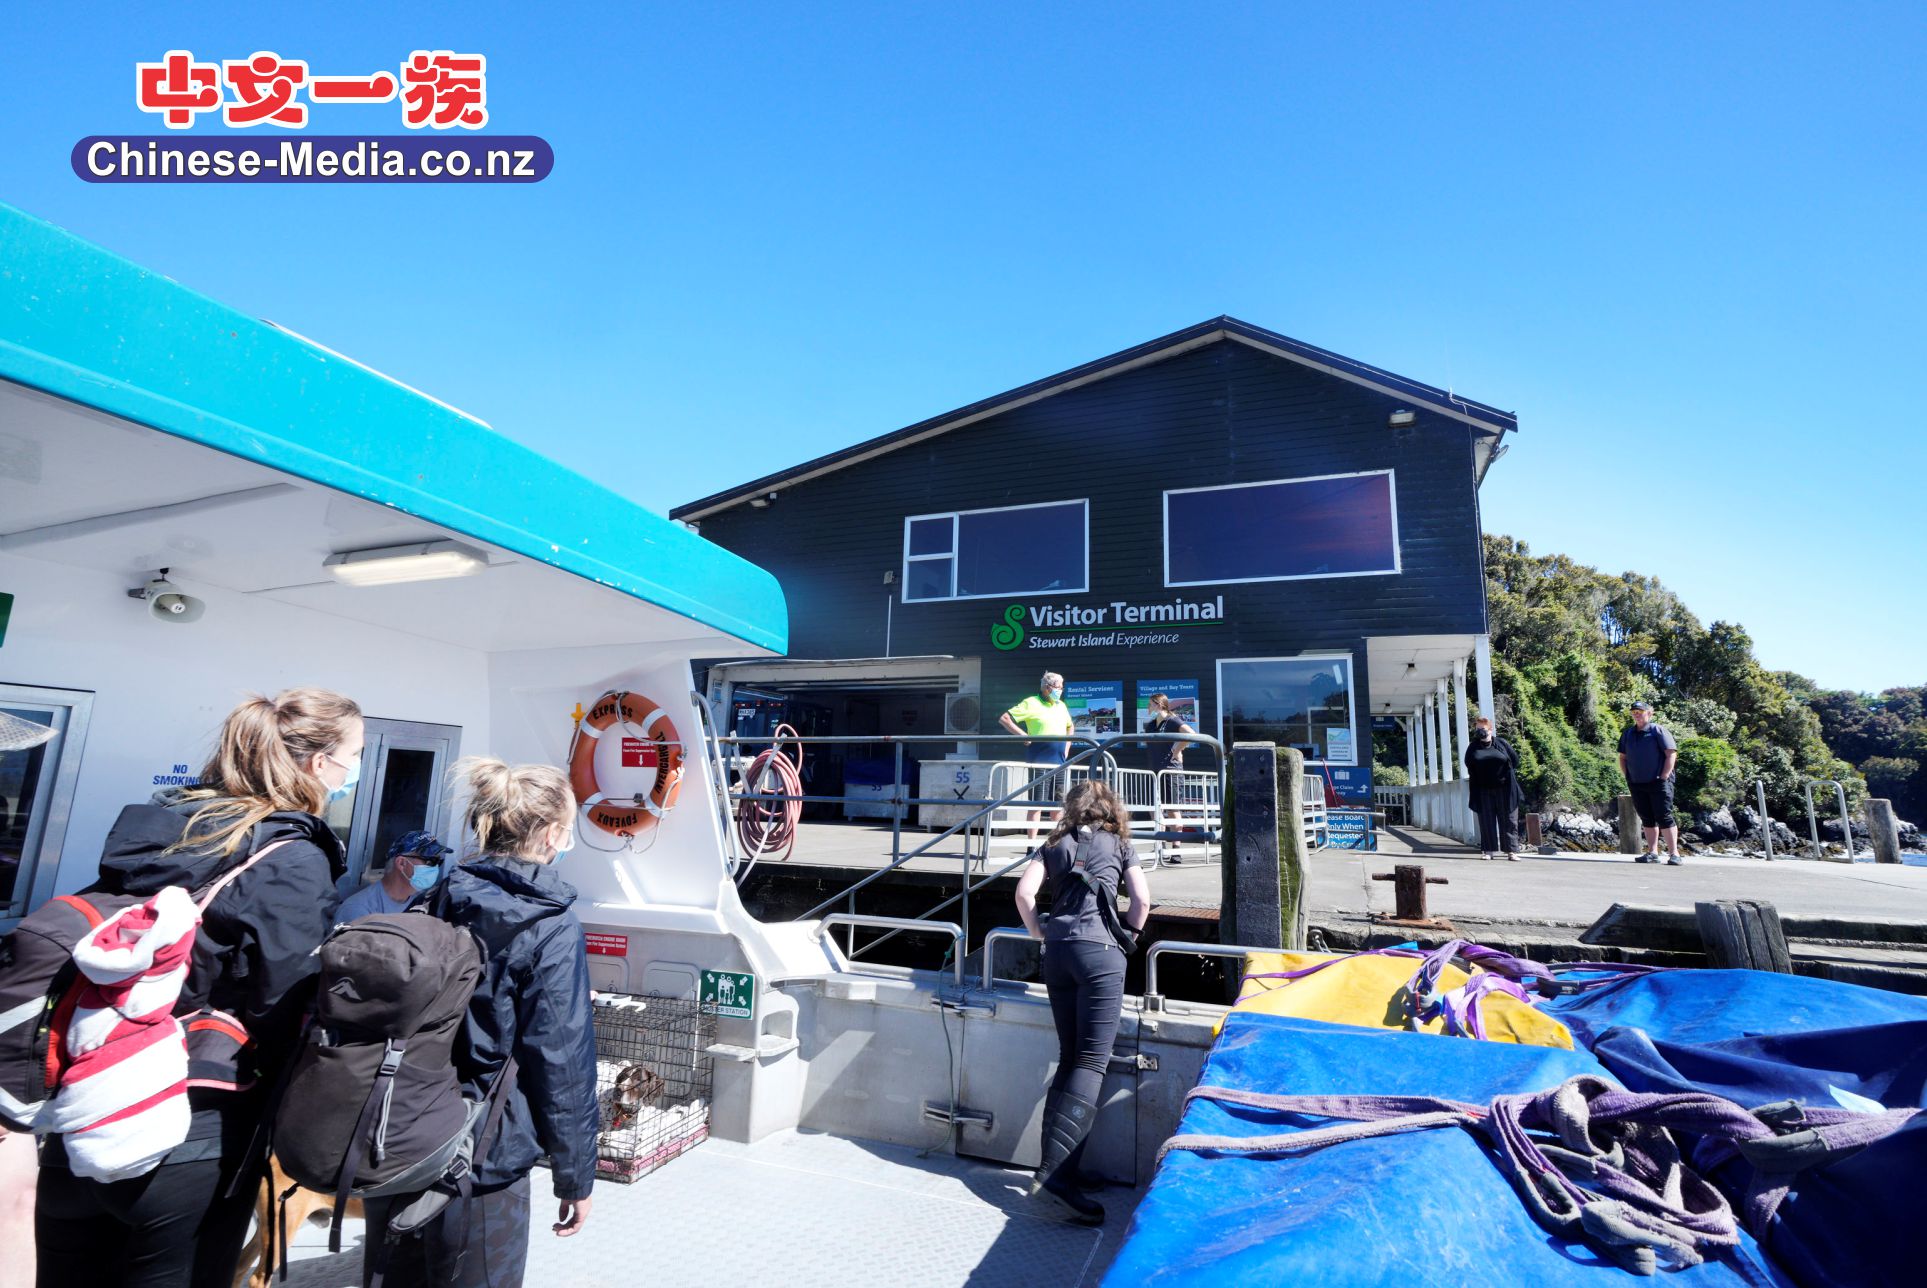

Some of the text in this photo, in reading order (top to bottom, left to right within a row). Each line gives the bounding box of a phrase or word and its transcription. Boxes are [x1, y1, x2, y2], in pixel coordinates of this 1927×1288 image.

[1029, 595, 1224, 627] Visitor Terminal
[1029, 631, 1179, 649] Stewart Island Experience
[592, 704, 633, 720] EXPRSS
[172, 764, 188, 774] NO
[955, 772, 970, 784] 55
[597, 811, 638, 828] FOVEAUX
